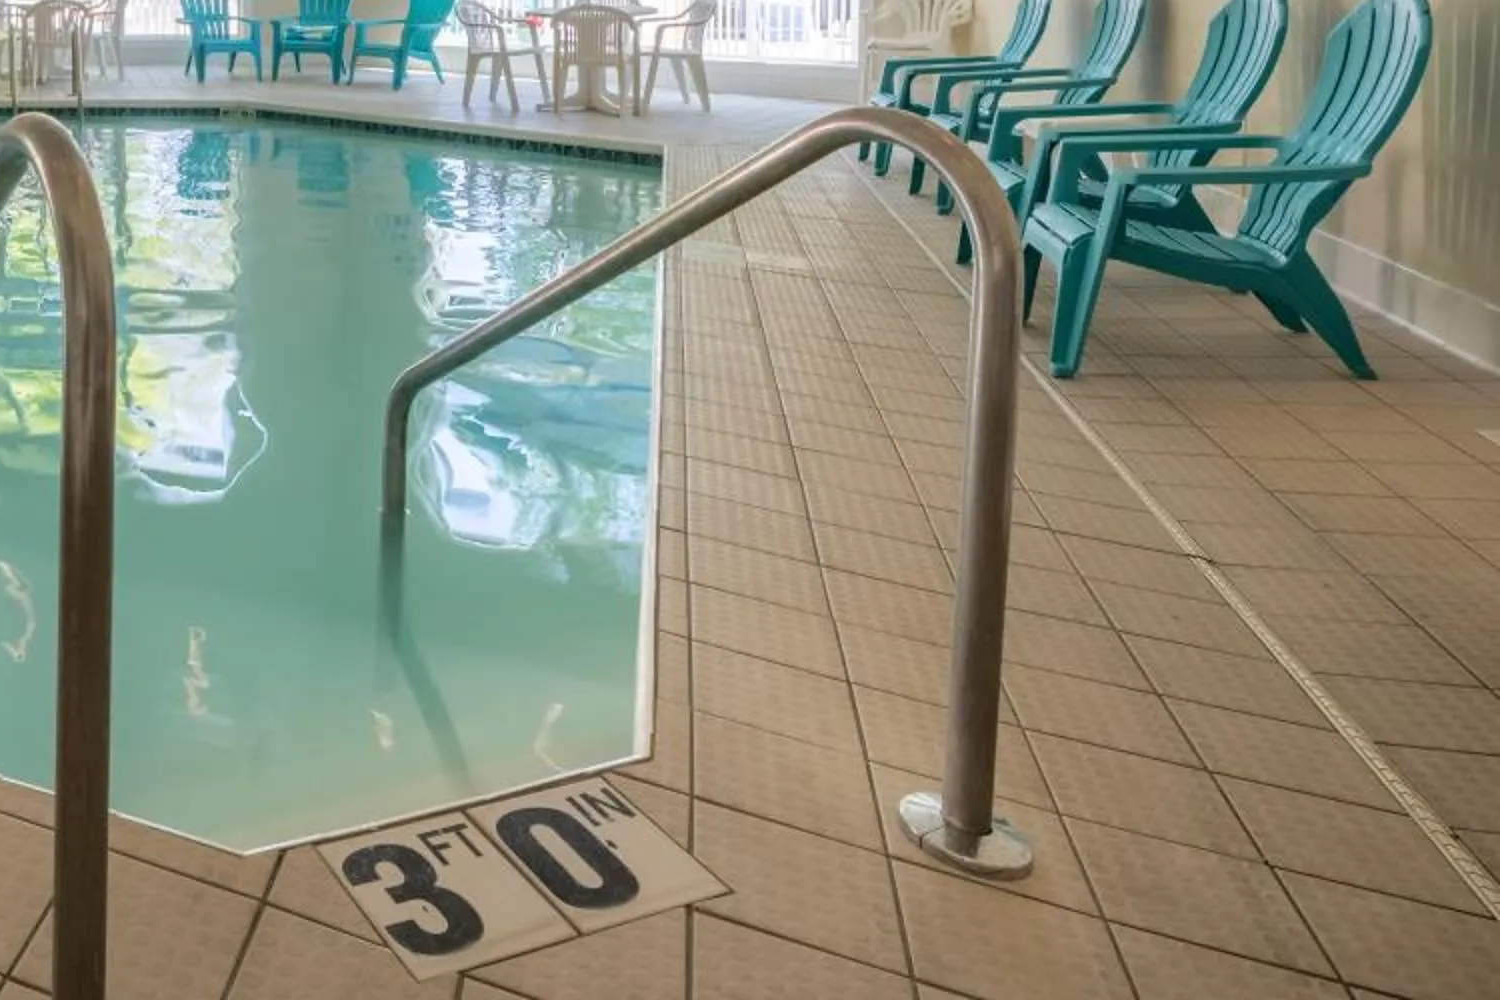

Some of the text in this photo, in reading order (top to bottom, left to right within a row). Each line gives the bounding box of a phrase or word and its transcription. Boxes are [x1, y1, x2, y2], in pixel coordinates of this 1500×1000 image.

[342, 786, 640, 956] 3 FT 0 IN
